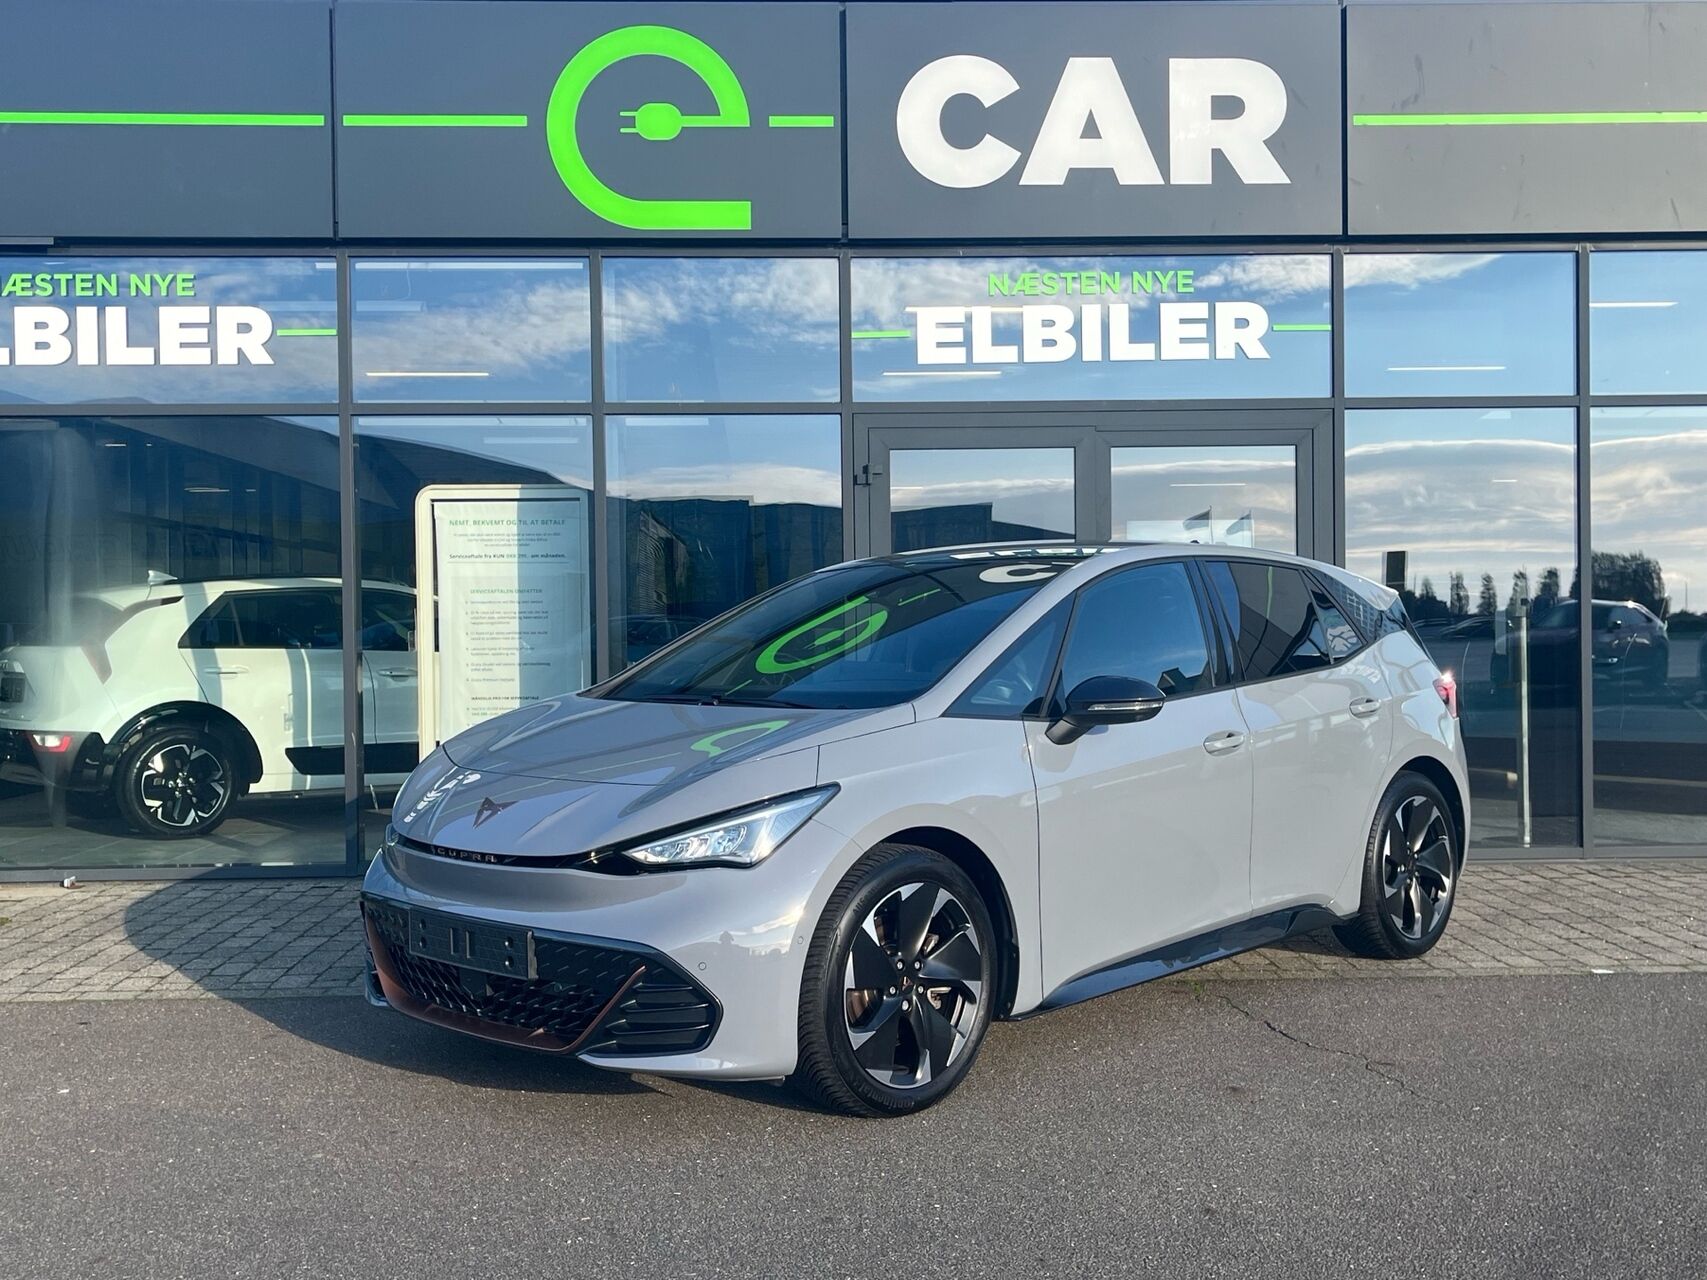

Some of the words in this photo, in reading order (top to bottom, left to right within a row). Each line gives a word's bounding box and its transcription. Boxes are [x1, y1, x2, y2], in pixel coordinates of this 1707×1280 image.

[896, 55, 1291, 189] CAR
[130, 272, 195, 296] NYE
[988, 271, 1121, 296] NÆSTEN
[1132, 270, 1195, 294] NYE
[0, 305, 275, 366] BILER
[915, 301, 1271, 365] ELBILER
[437, 847, 498, 863] CUPRA
